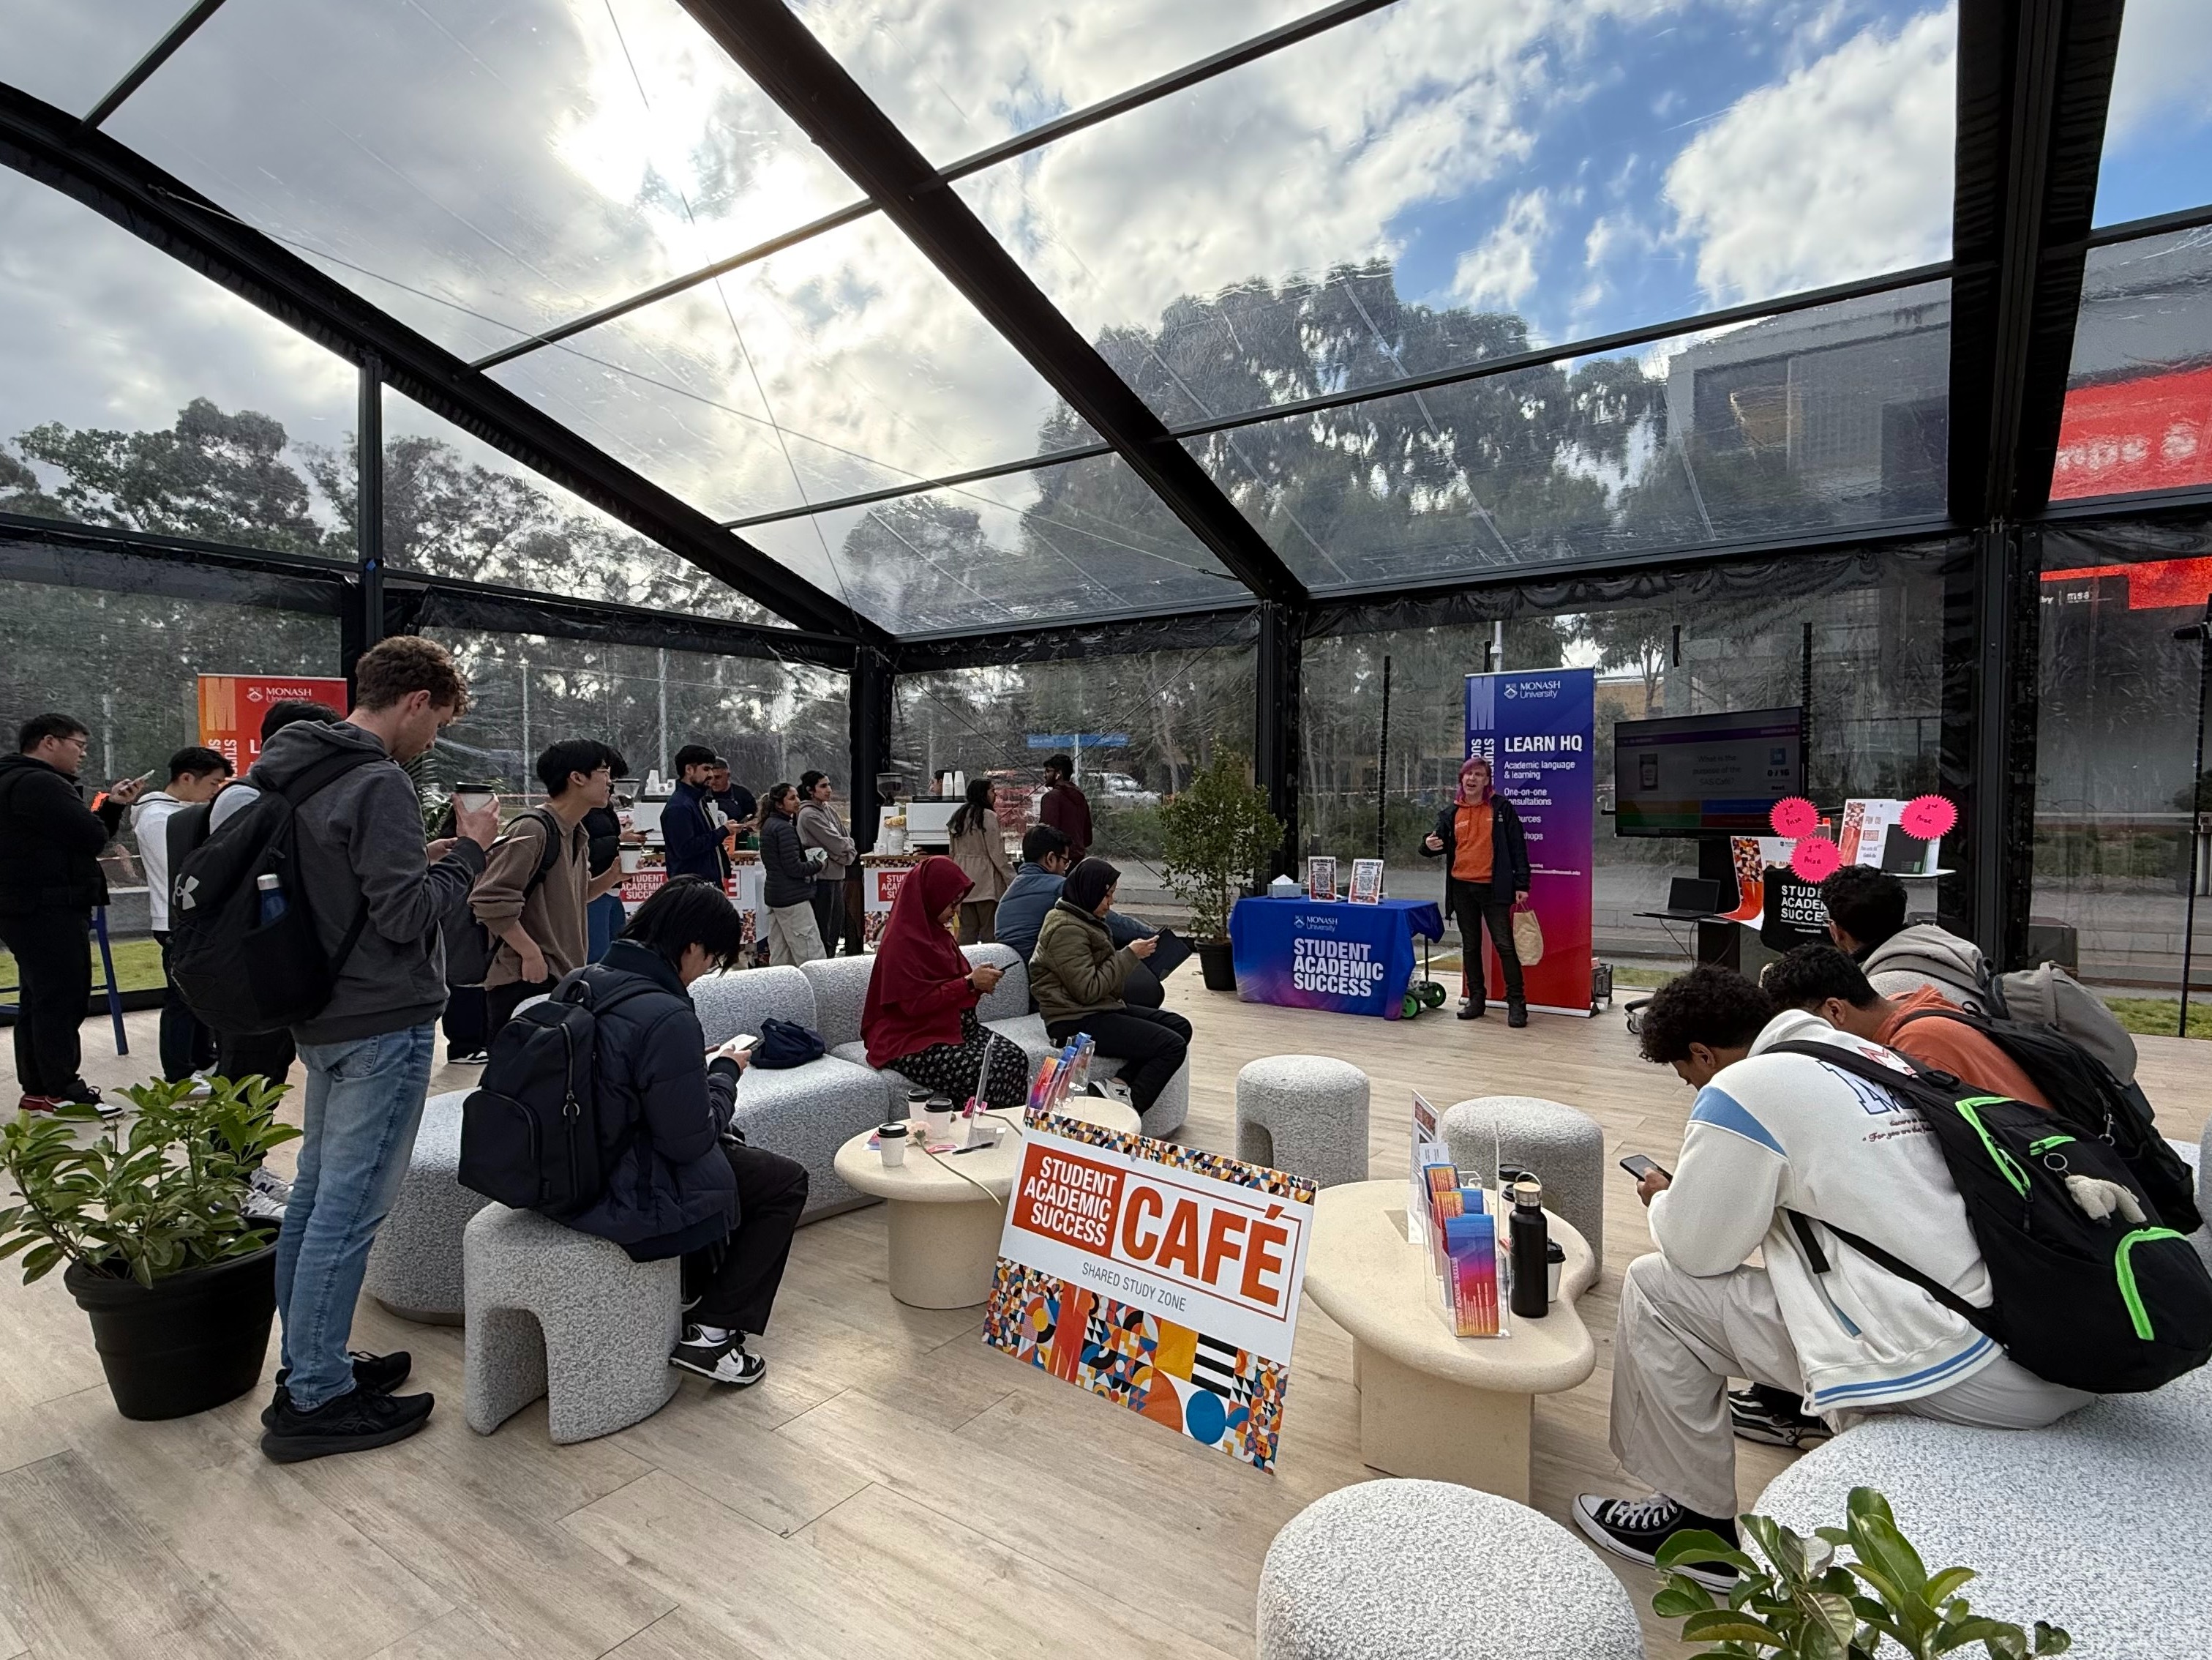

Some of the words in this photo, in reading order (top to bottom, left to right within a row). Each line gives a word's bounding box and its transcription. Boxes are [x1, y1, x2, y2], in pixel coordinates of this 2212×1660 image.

[266, 687, 312, 696] MONASH
[1520, 681, 1560, 691] MONASH
[1520, 689, 1559, 699] University
[1505, 736, 1556, 752] LEARN
[1560, 735, 1583, 752] HQ
[1504, 761, 1539, 769] Academic
[1541, 760, 1575, 770] language
[1504, 771, 1510, 779] &
[1512, 770, 1541, 780] learning
[1504, 788, 1548, 796] One-on-one
[632, 874, 664, 883] TUDENT
[1307, 916, 1338, 925] MONASH
[1781, 908, 1823, 922] SUCCE
[1306, 923, 1336, 932] University
[1294, 938, 1371, 961] STUDENT
[1293, 956, 1384, 980] ACADEMIC
[1294, 973, 1372, 997] SUCCESS
[1040, 1156, 1117, 1197] STUDENT
[1023, 1176, 1111, 1222] ACADEMIC
[1030, 1202, 1107, 1246] SUCCESS
[1122, 1186, 1288, 1307] CAFÉ
[1081, 1262, 1120, 1286] SHARED
[1122, 1276, 1156, 1298] STUDY
[1158, 1290, 1187, 1312] ZONE
